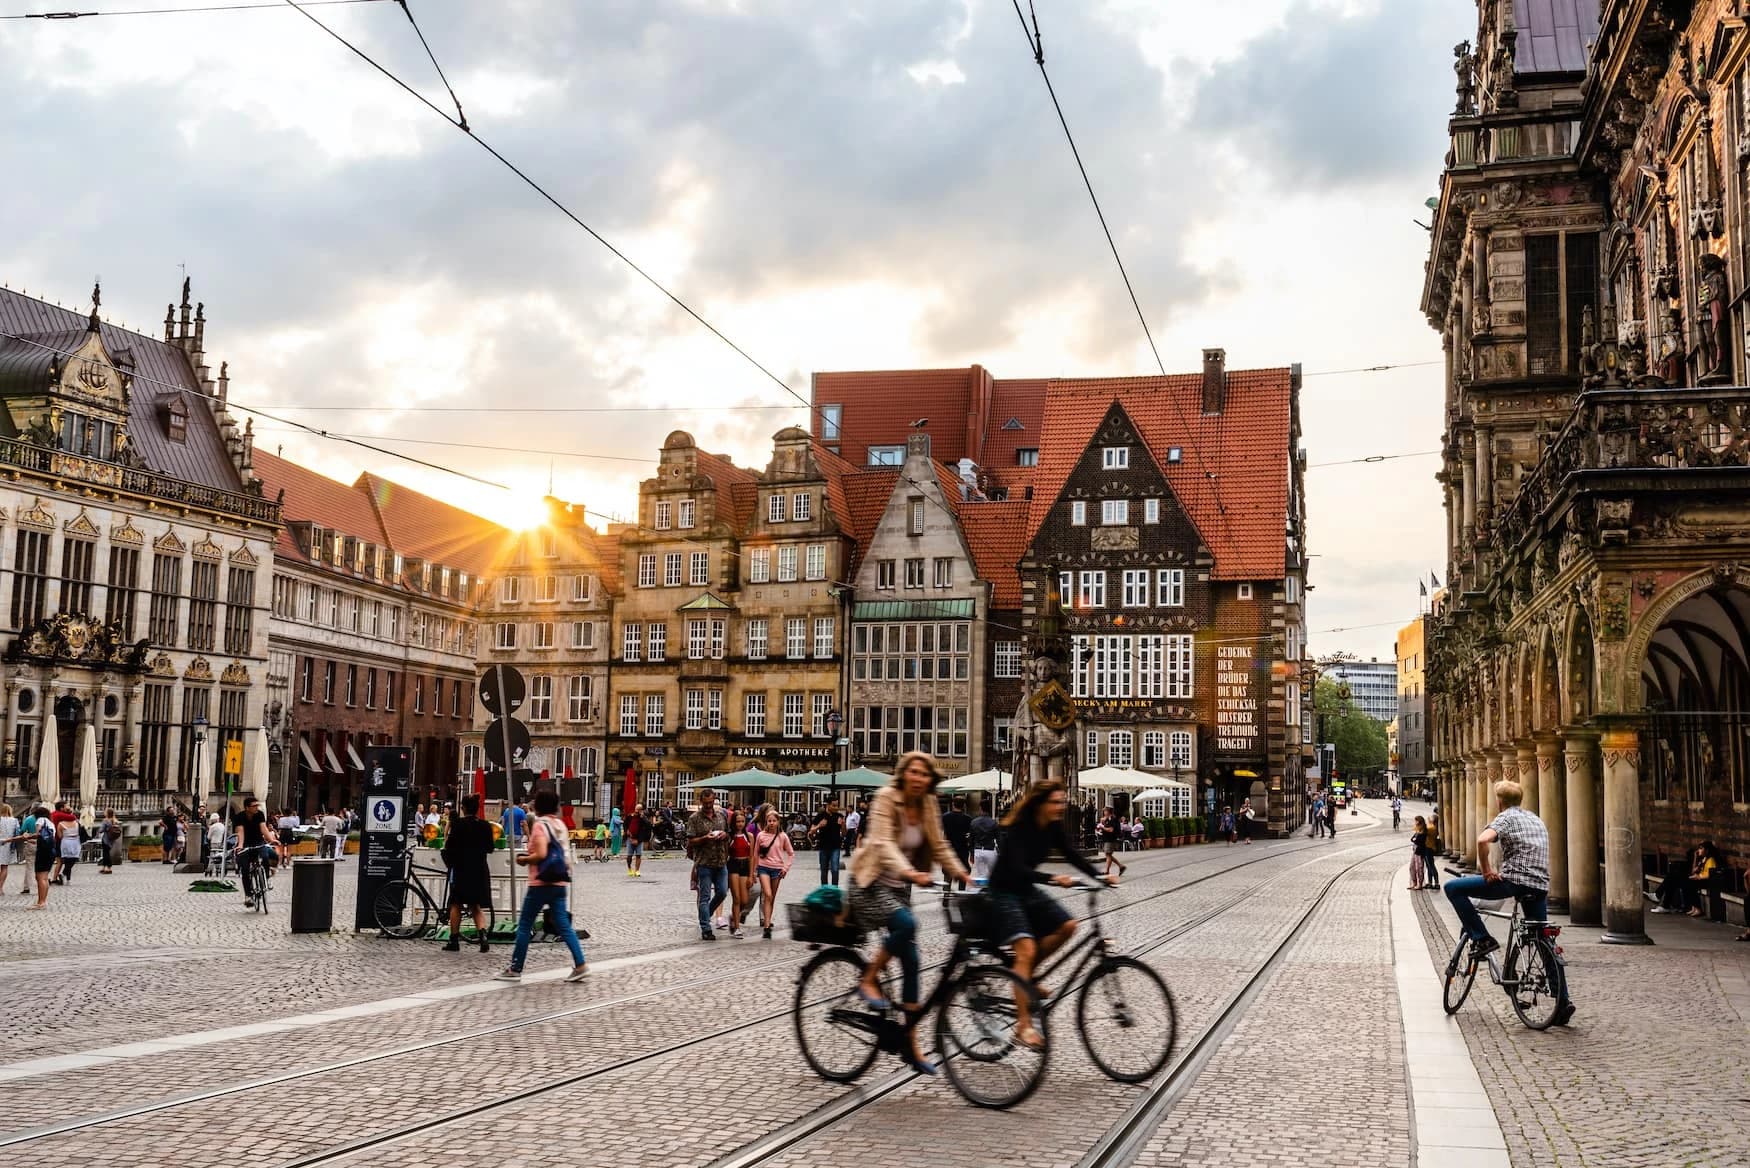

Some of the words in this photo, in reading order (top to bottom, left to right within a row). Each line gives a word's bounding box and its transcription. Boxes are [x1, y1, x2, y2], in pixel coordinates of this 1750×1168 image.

[1217, 646, 1252, 658] GEDENKE
[1217, 660, 1233, 671] DER
[1217, 672, 1252, 684] BRÜDER,
[1217, 686, 1230, 697] DIE
[1232, 686, 1247, 697] DAS
[1104, 699, 1118, 707] AM
[1120, 699, 1153, 707] MARKT
[1217, 699, 1258, 710] SCHICKSAL
[1217, 712, 1252, 723] UNSERER
[1217, 725, 1258, 737] TRENNUNG
[737, 748, 767, 756] RATHS
[780, 748, 830, 757] APOTHEKE
